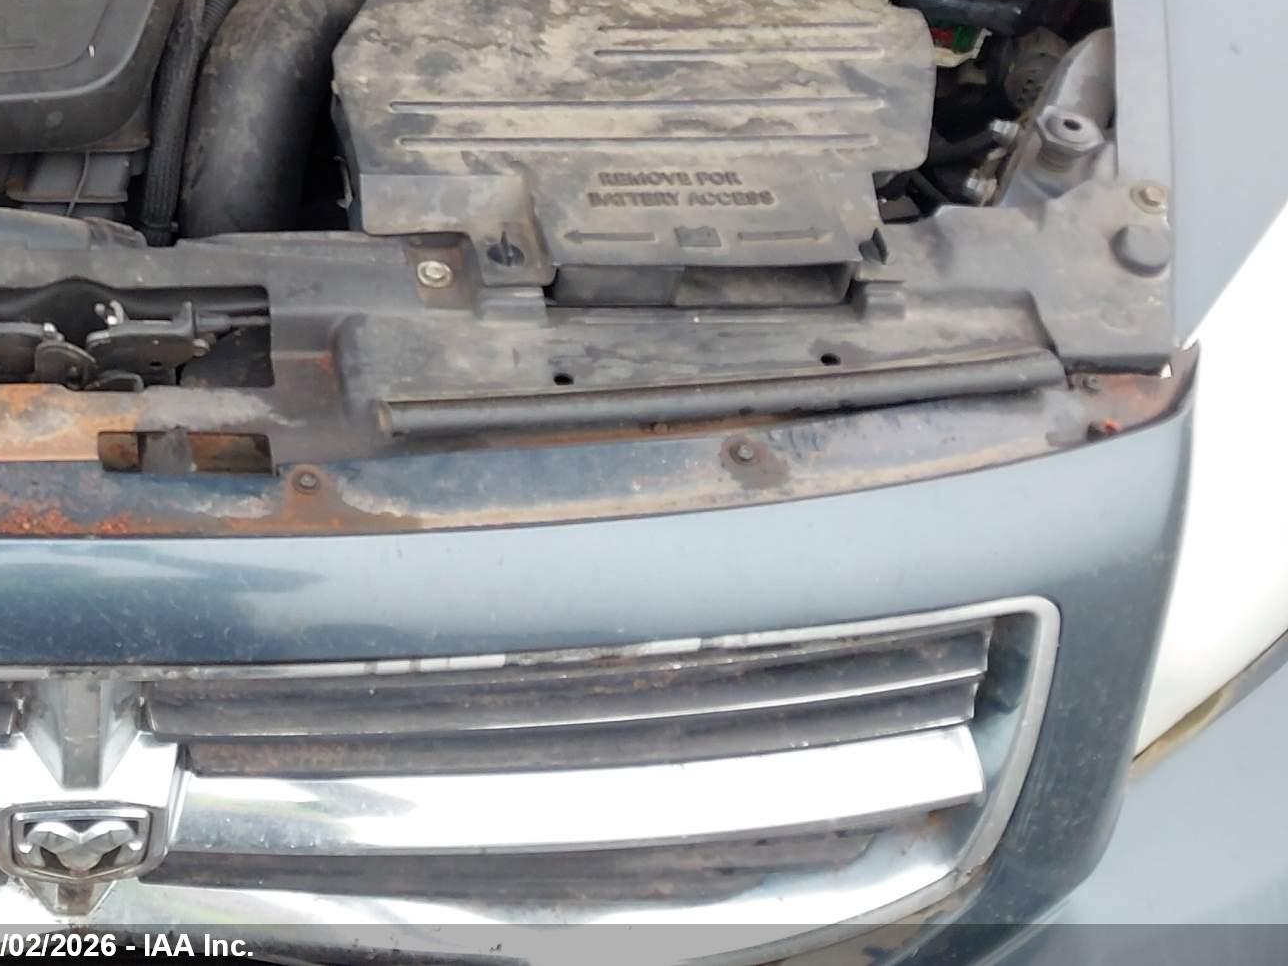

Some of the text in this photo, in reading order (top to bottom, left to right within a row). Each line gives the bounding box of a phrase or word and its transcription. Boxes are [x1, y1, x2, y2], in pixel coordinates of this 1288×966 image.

[598, 171, 743, 186] REMOVE FOR
[588, 190, 775, 207] BATTERY ACCESS
